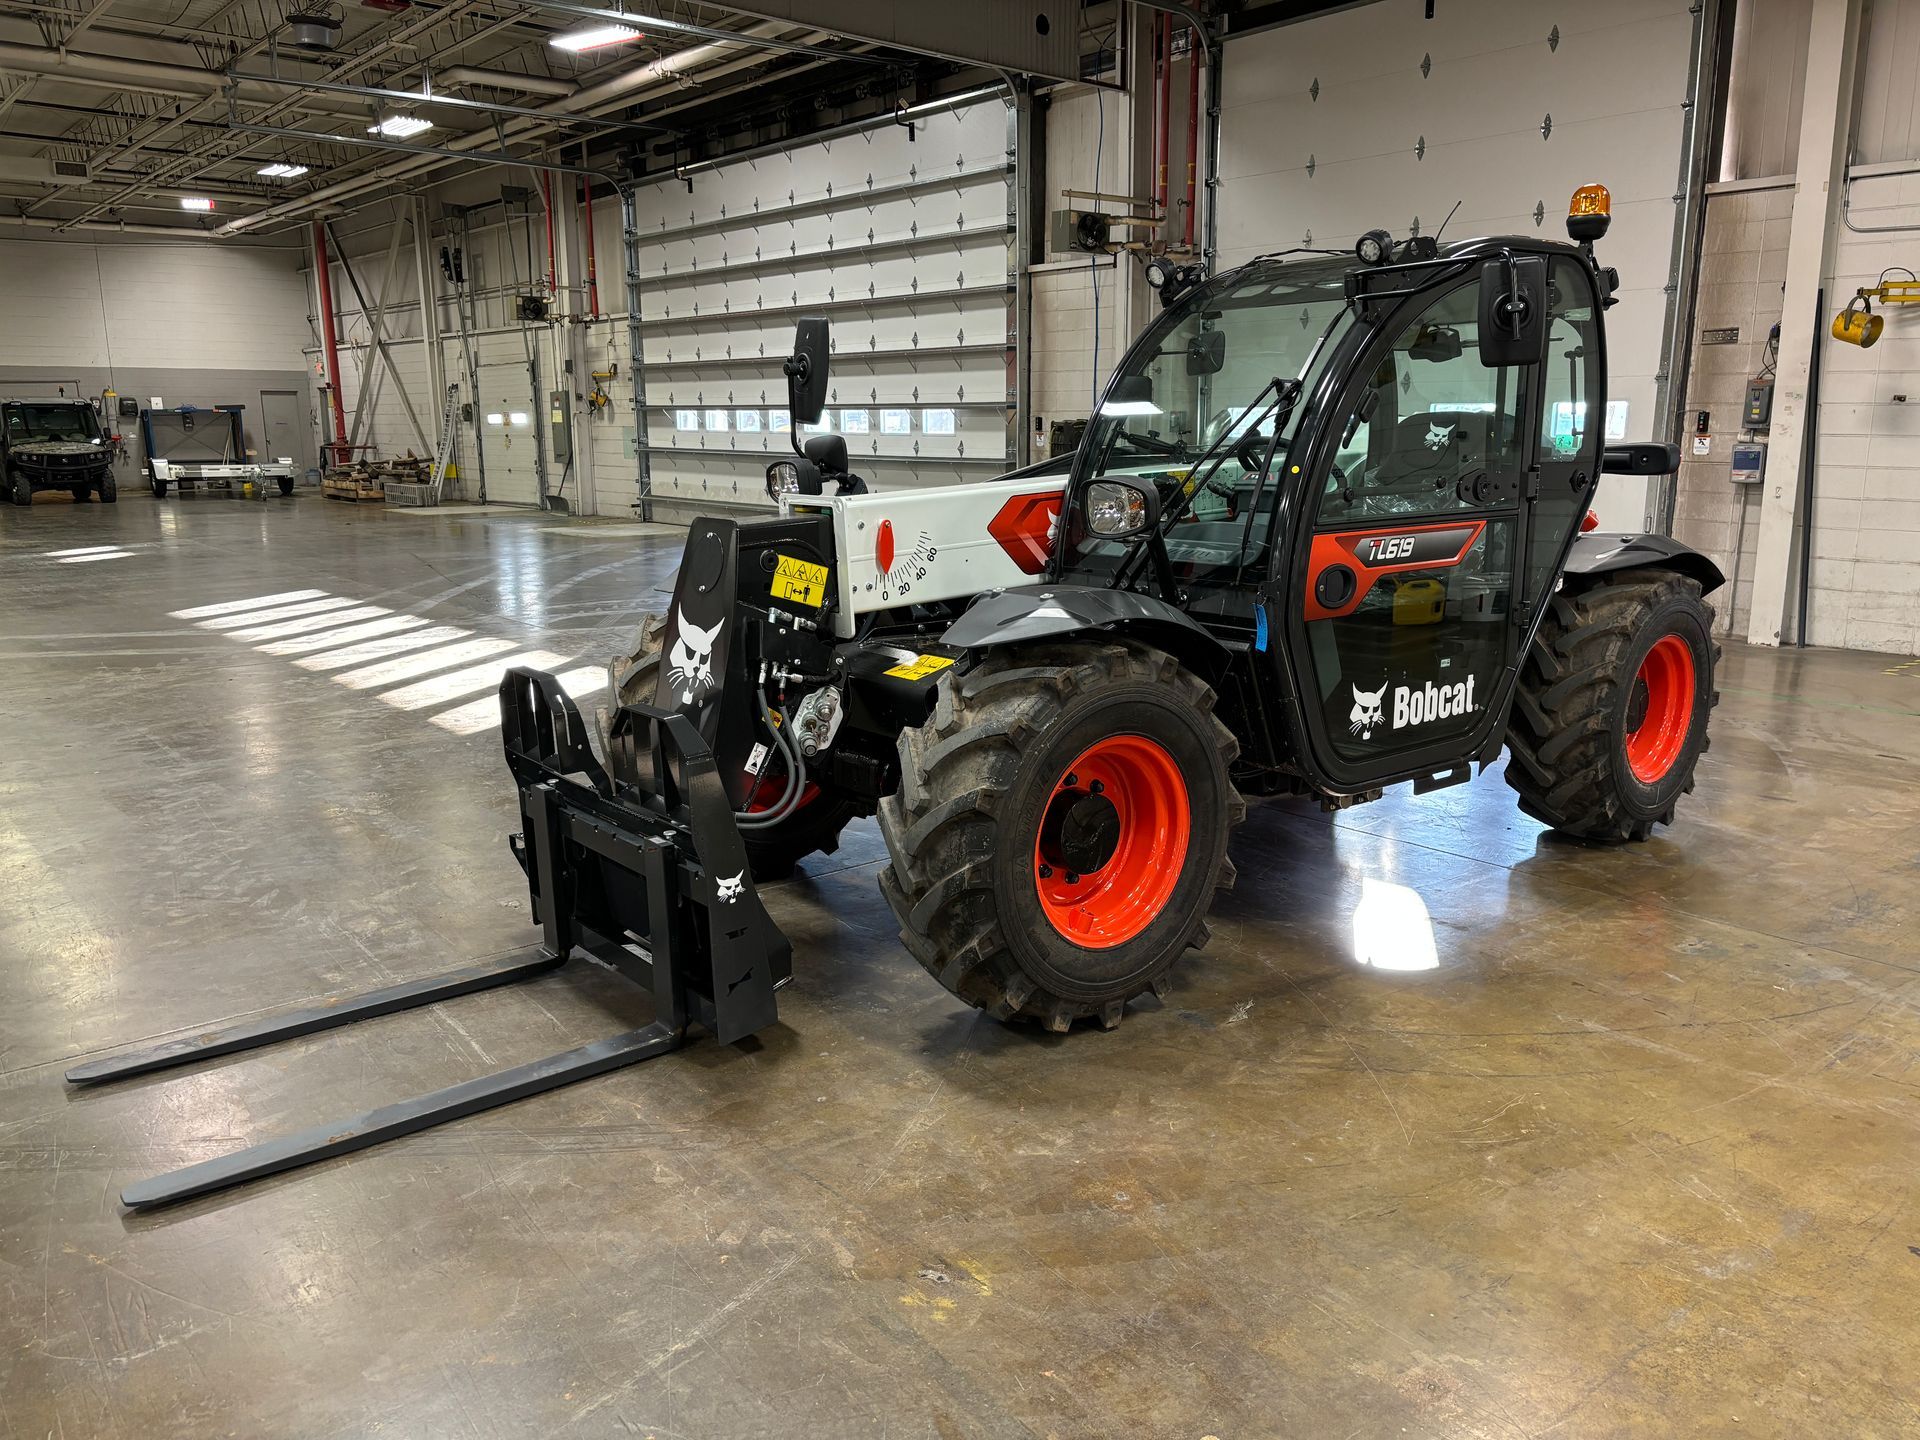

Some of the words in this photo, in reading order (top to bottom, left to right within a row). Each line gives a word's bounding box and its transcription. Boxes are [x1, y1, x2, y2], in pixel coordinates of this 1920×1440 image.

[882, 590, 889, 601] 0
[898, 582, 911, 596] 20
[915, 566, 927, 581] 40
[926, 547, 938, 562] 60
[1369, 537, 1416, 561] TL619
[1393, 674, 1475, 730] Bobcat
